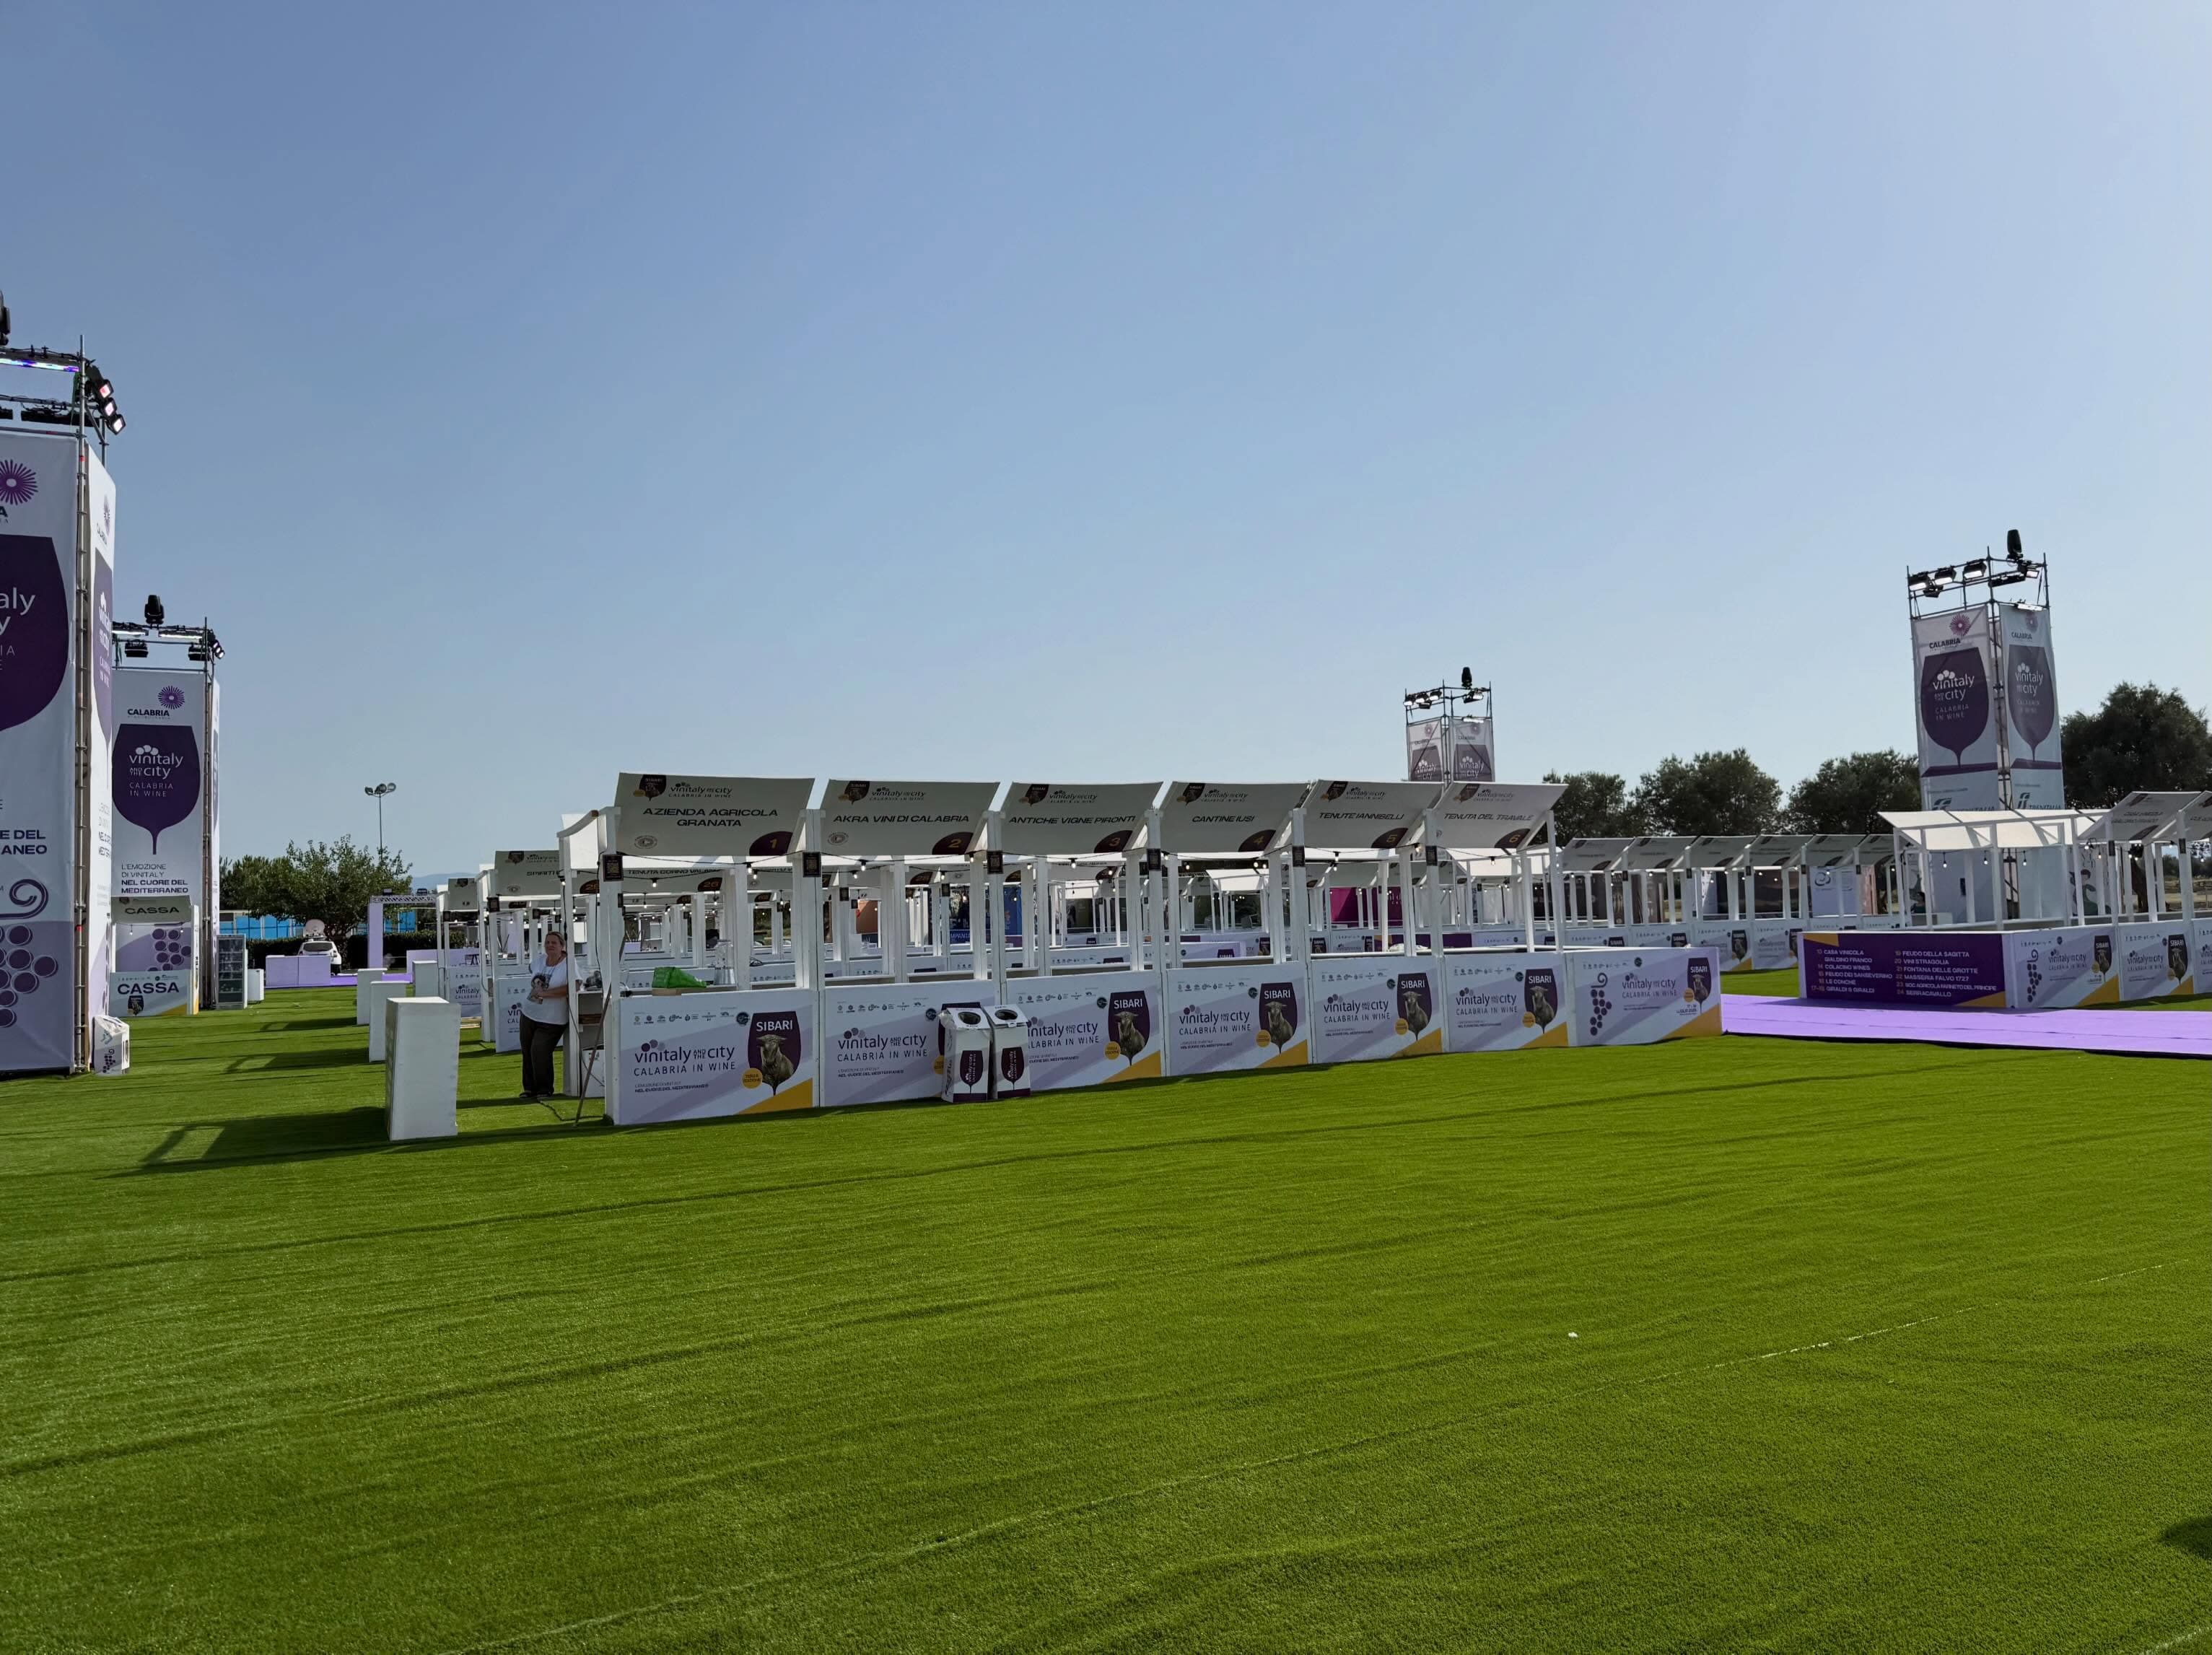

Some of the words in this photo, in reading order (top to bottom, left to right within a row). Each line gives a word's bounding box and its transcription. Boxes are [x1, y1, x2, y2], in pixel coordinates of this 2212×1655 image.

[1928, 638, 1961, 649] CALABRIA
[1933, 673, 1975, 691] vinitaly
[2015, 671, 2043, 686] vinitaly
[1945, 689, 1966, 702] city
[2023, 684, 2037, 697] city
[127, 708, 170, 717] CALABRIA
[129, 753, 183, 768] vinitaly
[144, 767, 171, 780] city
[715, 786, 732, 795] city
[643, 808, 706, 816] AZIENDA
[709, 808, 779, 817] AGRICOLA
[14, 829, 46, 839] DEL
[1386, 834, 1397, 843] 5
[769, 838, 777, 849] 1
[949, 839, 962, 847] 2
[1109, 837, 1121, 847] 3
[117, 982, 180, 995] CASSA
[1402, 979, 1425, 989] SIBARI
[1622, 978, 1653, 990] vinitaly
[1661, 979, 1677, 990] city
[1264, 990, 1290, 1000] SIBARI
[1456, 993, 1490, 1006] vinitaly
[1500, 993, 1516, 1004] city
[1114, 998, 1142, 1009] SIBARI
[1324, 1000, 1360, 1013] vinitaly
[1371, 1000, 1389, 1011] city
[1179, 1010, 1219, 1025] vinitaly
[1230, 1011, 1250, 1023] city
[756, 1020, 793, 1031] SIBARI
[1077, 1022, 1098, 1034] city
[1179, 1026, 1217, 1035] CALABRIA
[838, 1034, 888, 1051] vinitaly
[902, 1034, 927, 1047] city
[1078, 1035, 1099, 1044] WINE
[634, 1046, 691, 1064] vinitaly
[707, 1046, 735, 1060] city
[837, 1051, 884, 1062] CALABRIA
[889, 1050, 899, 1059] IN
[904, 1048, 927, 1057] WINE
[634, 1063, 687, 1076] CALABRIA
[693, 1062, 704, 1072] IN
[709, 1061, 736, 1071] WINE
